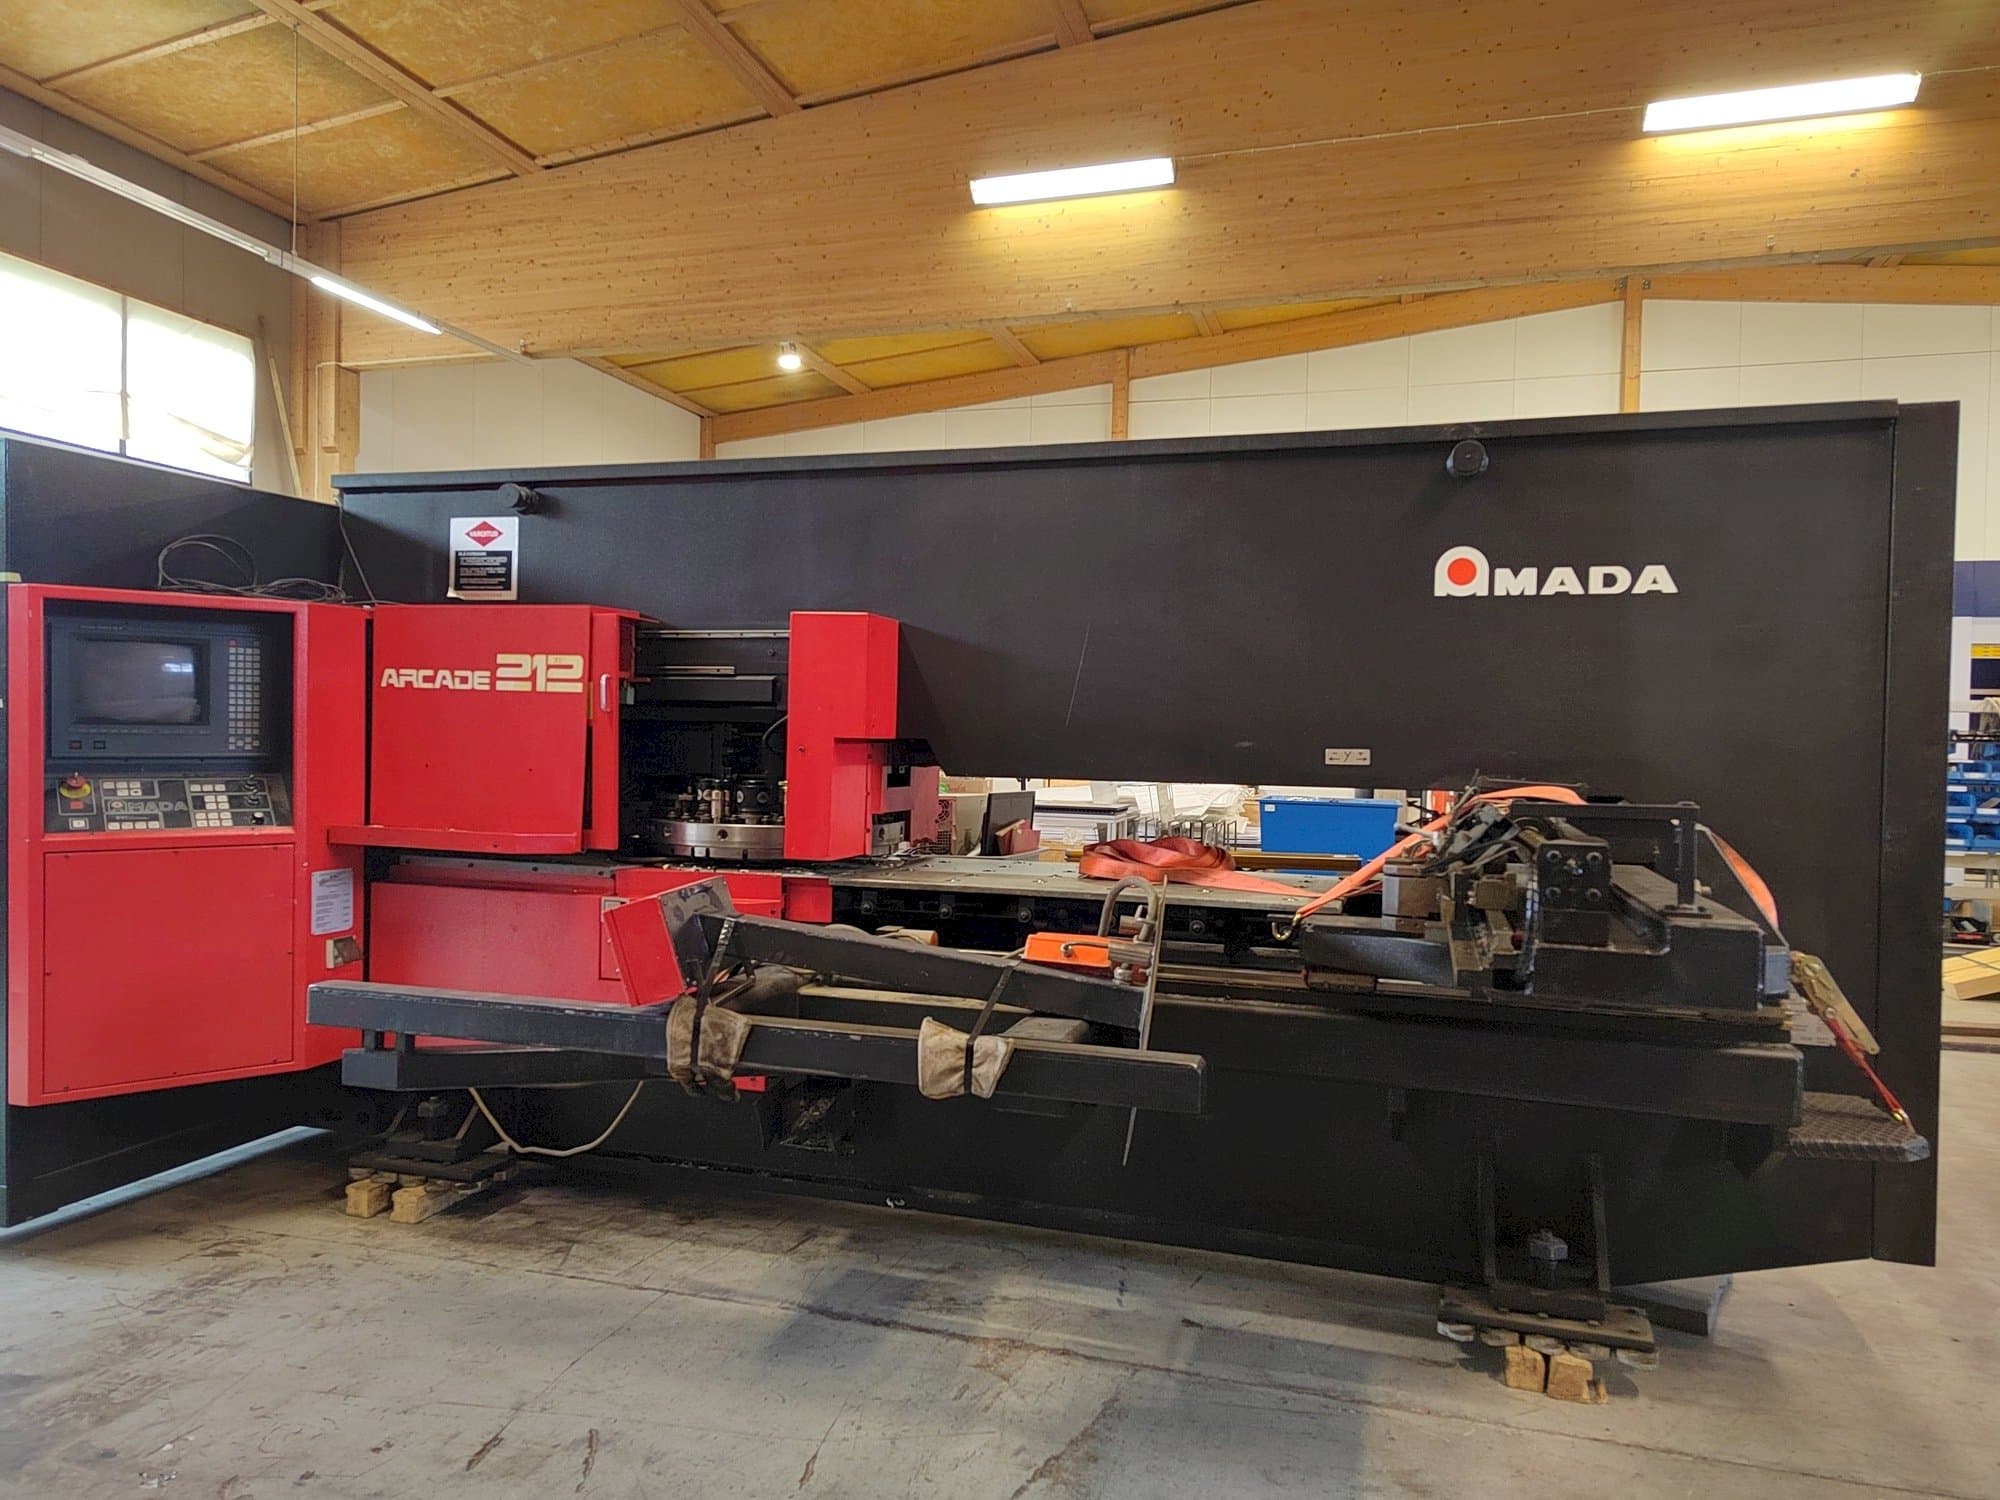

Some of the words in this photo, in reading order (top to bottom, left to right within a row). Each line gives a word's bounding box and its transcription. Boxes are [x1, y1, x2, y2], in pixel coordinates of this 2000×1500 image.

[1434, 545, 1679, 597] AMADA
[380, 667, 491, 691] ARCADE
[495, 653, 584, 693] 212
[108, 800, 189, 813] AMADA
